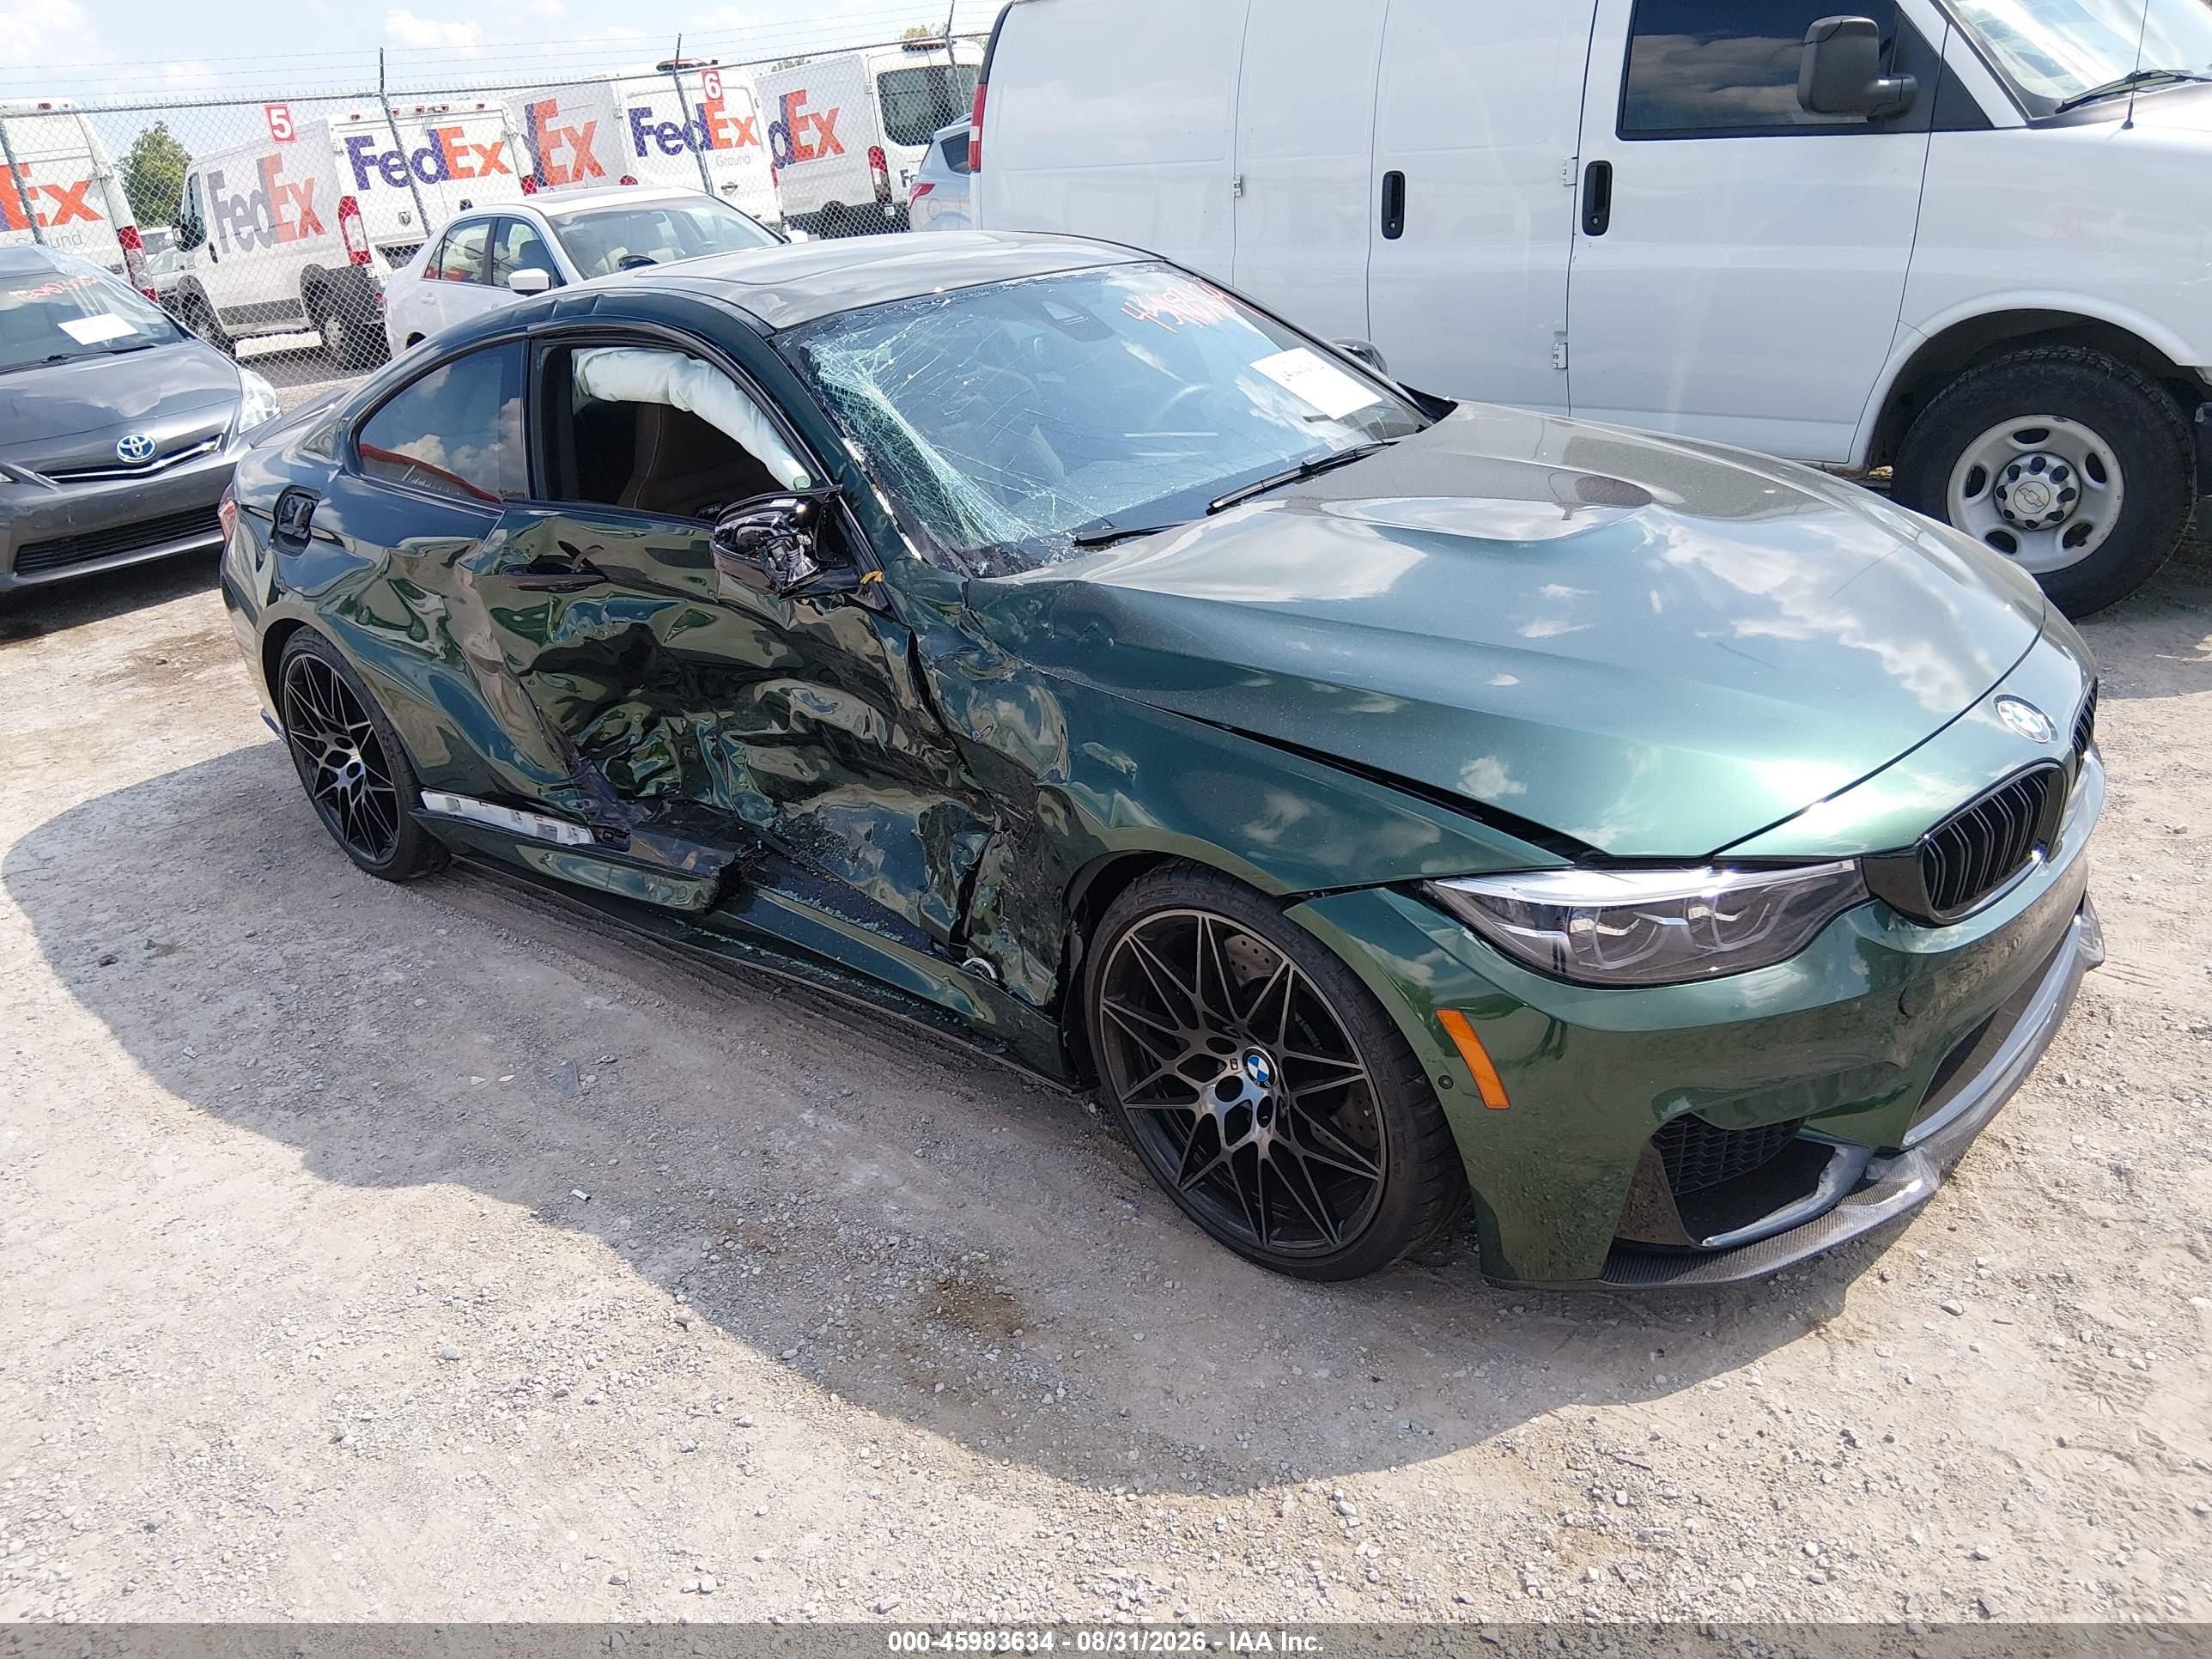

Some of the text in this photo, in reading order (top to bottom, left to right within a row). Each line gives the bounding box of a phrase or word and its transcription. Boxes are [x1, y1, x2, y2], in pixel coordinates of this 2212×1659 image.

[704, 72, 721, 100] 6
[270, 108, 292, 139] 5
[628, 101, 763, 157] FedEx
[344, 126, 514, 191] FedEx
[715, 155, 751, 167] Ground
[0, 162, 105, 231] Ex
[207, 153, 327, 254] FedEx
